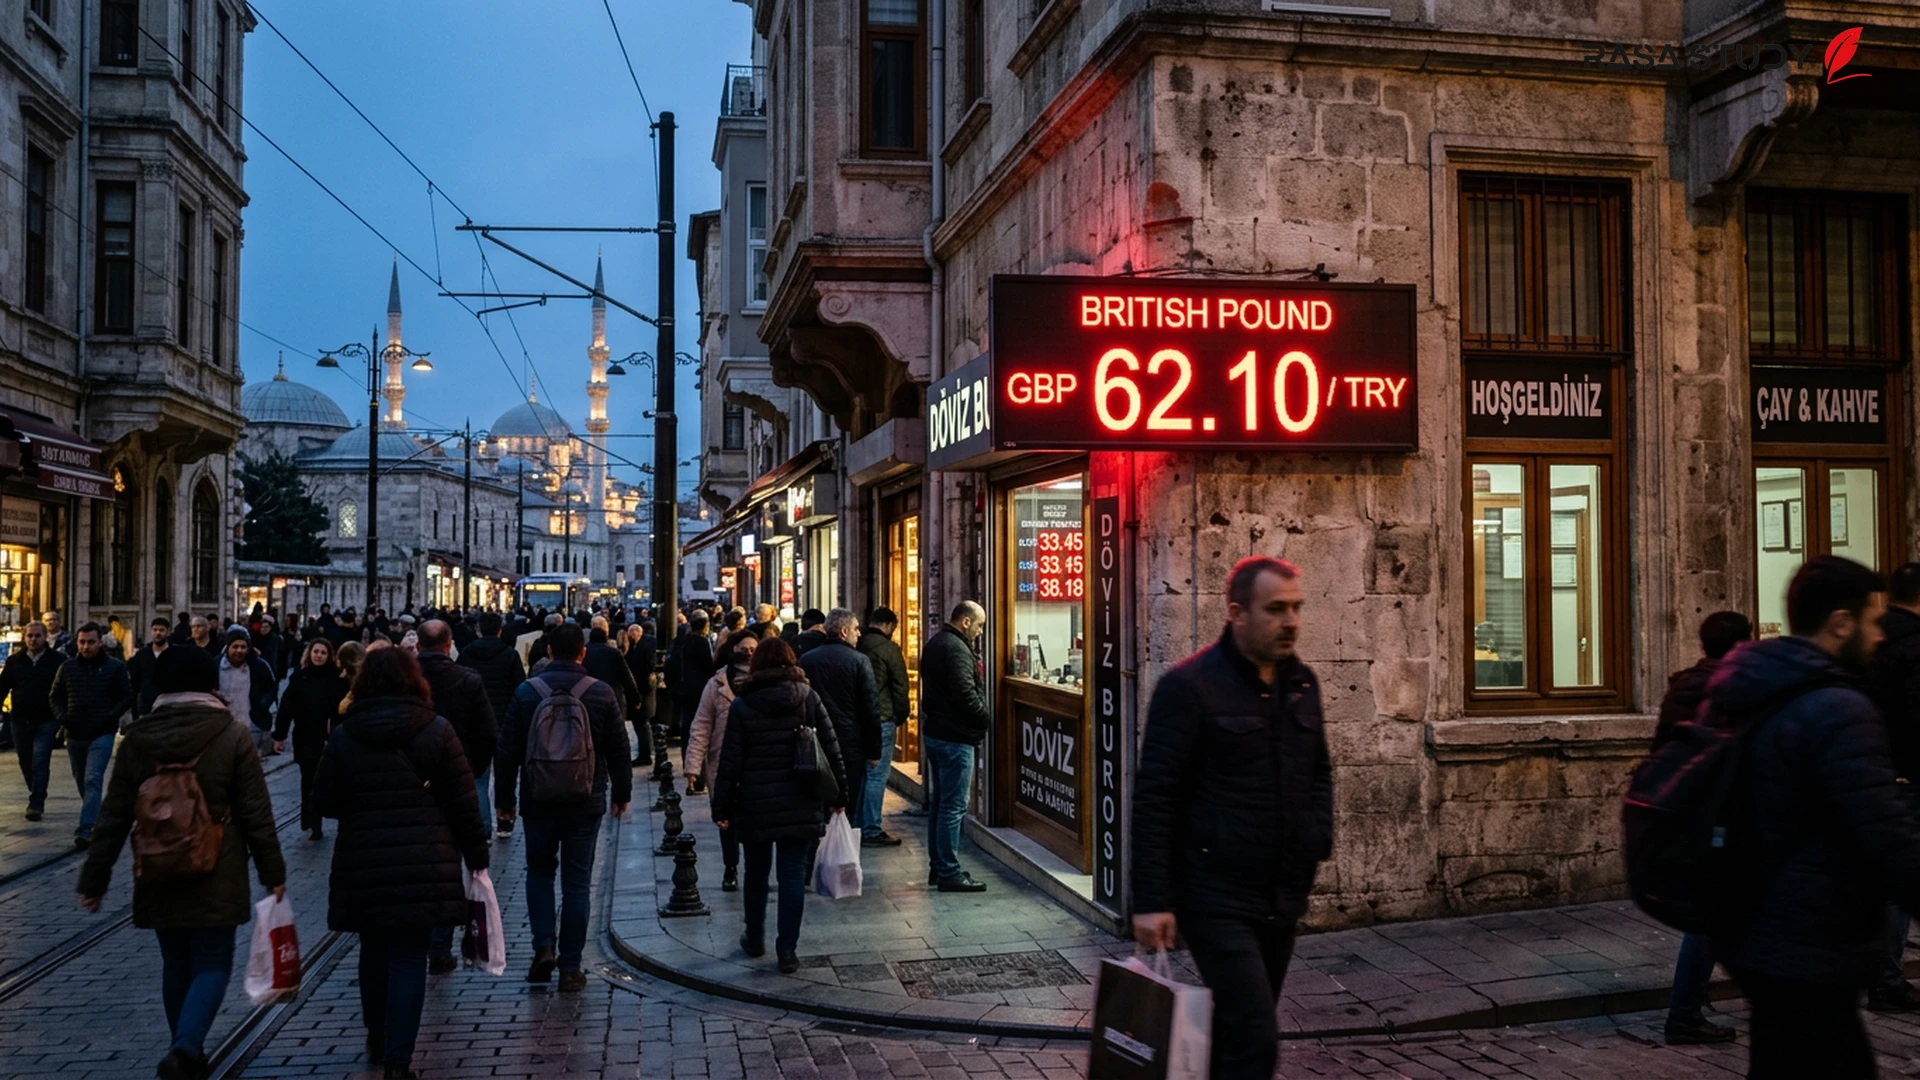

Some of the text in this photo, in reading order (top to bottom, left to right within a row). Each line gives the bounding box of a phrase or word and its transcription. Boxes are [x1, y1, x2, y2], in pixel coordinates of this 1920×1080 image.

[1080, 295, 1333, 332] BRITISH POUND
[1006, 371, 1078, 404] GBP
[1093, 347, 1319, 433] 62.10
[1344, 376, 1407, 407] TRY
[1471, 373, 1603, 425] HOŞGELDİNİZ
[1757, 386, 1879, 430] ÇAY & KAHVE
[1039, 532, 1084, 551] 33.45
[1039, 577, 1084, 597] 38.18
[1022, 716, 1075, 776] DÖVİZ
[1102, 687, 1116, 898] BUROSU
